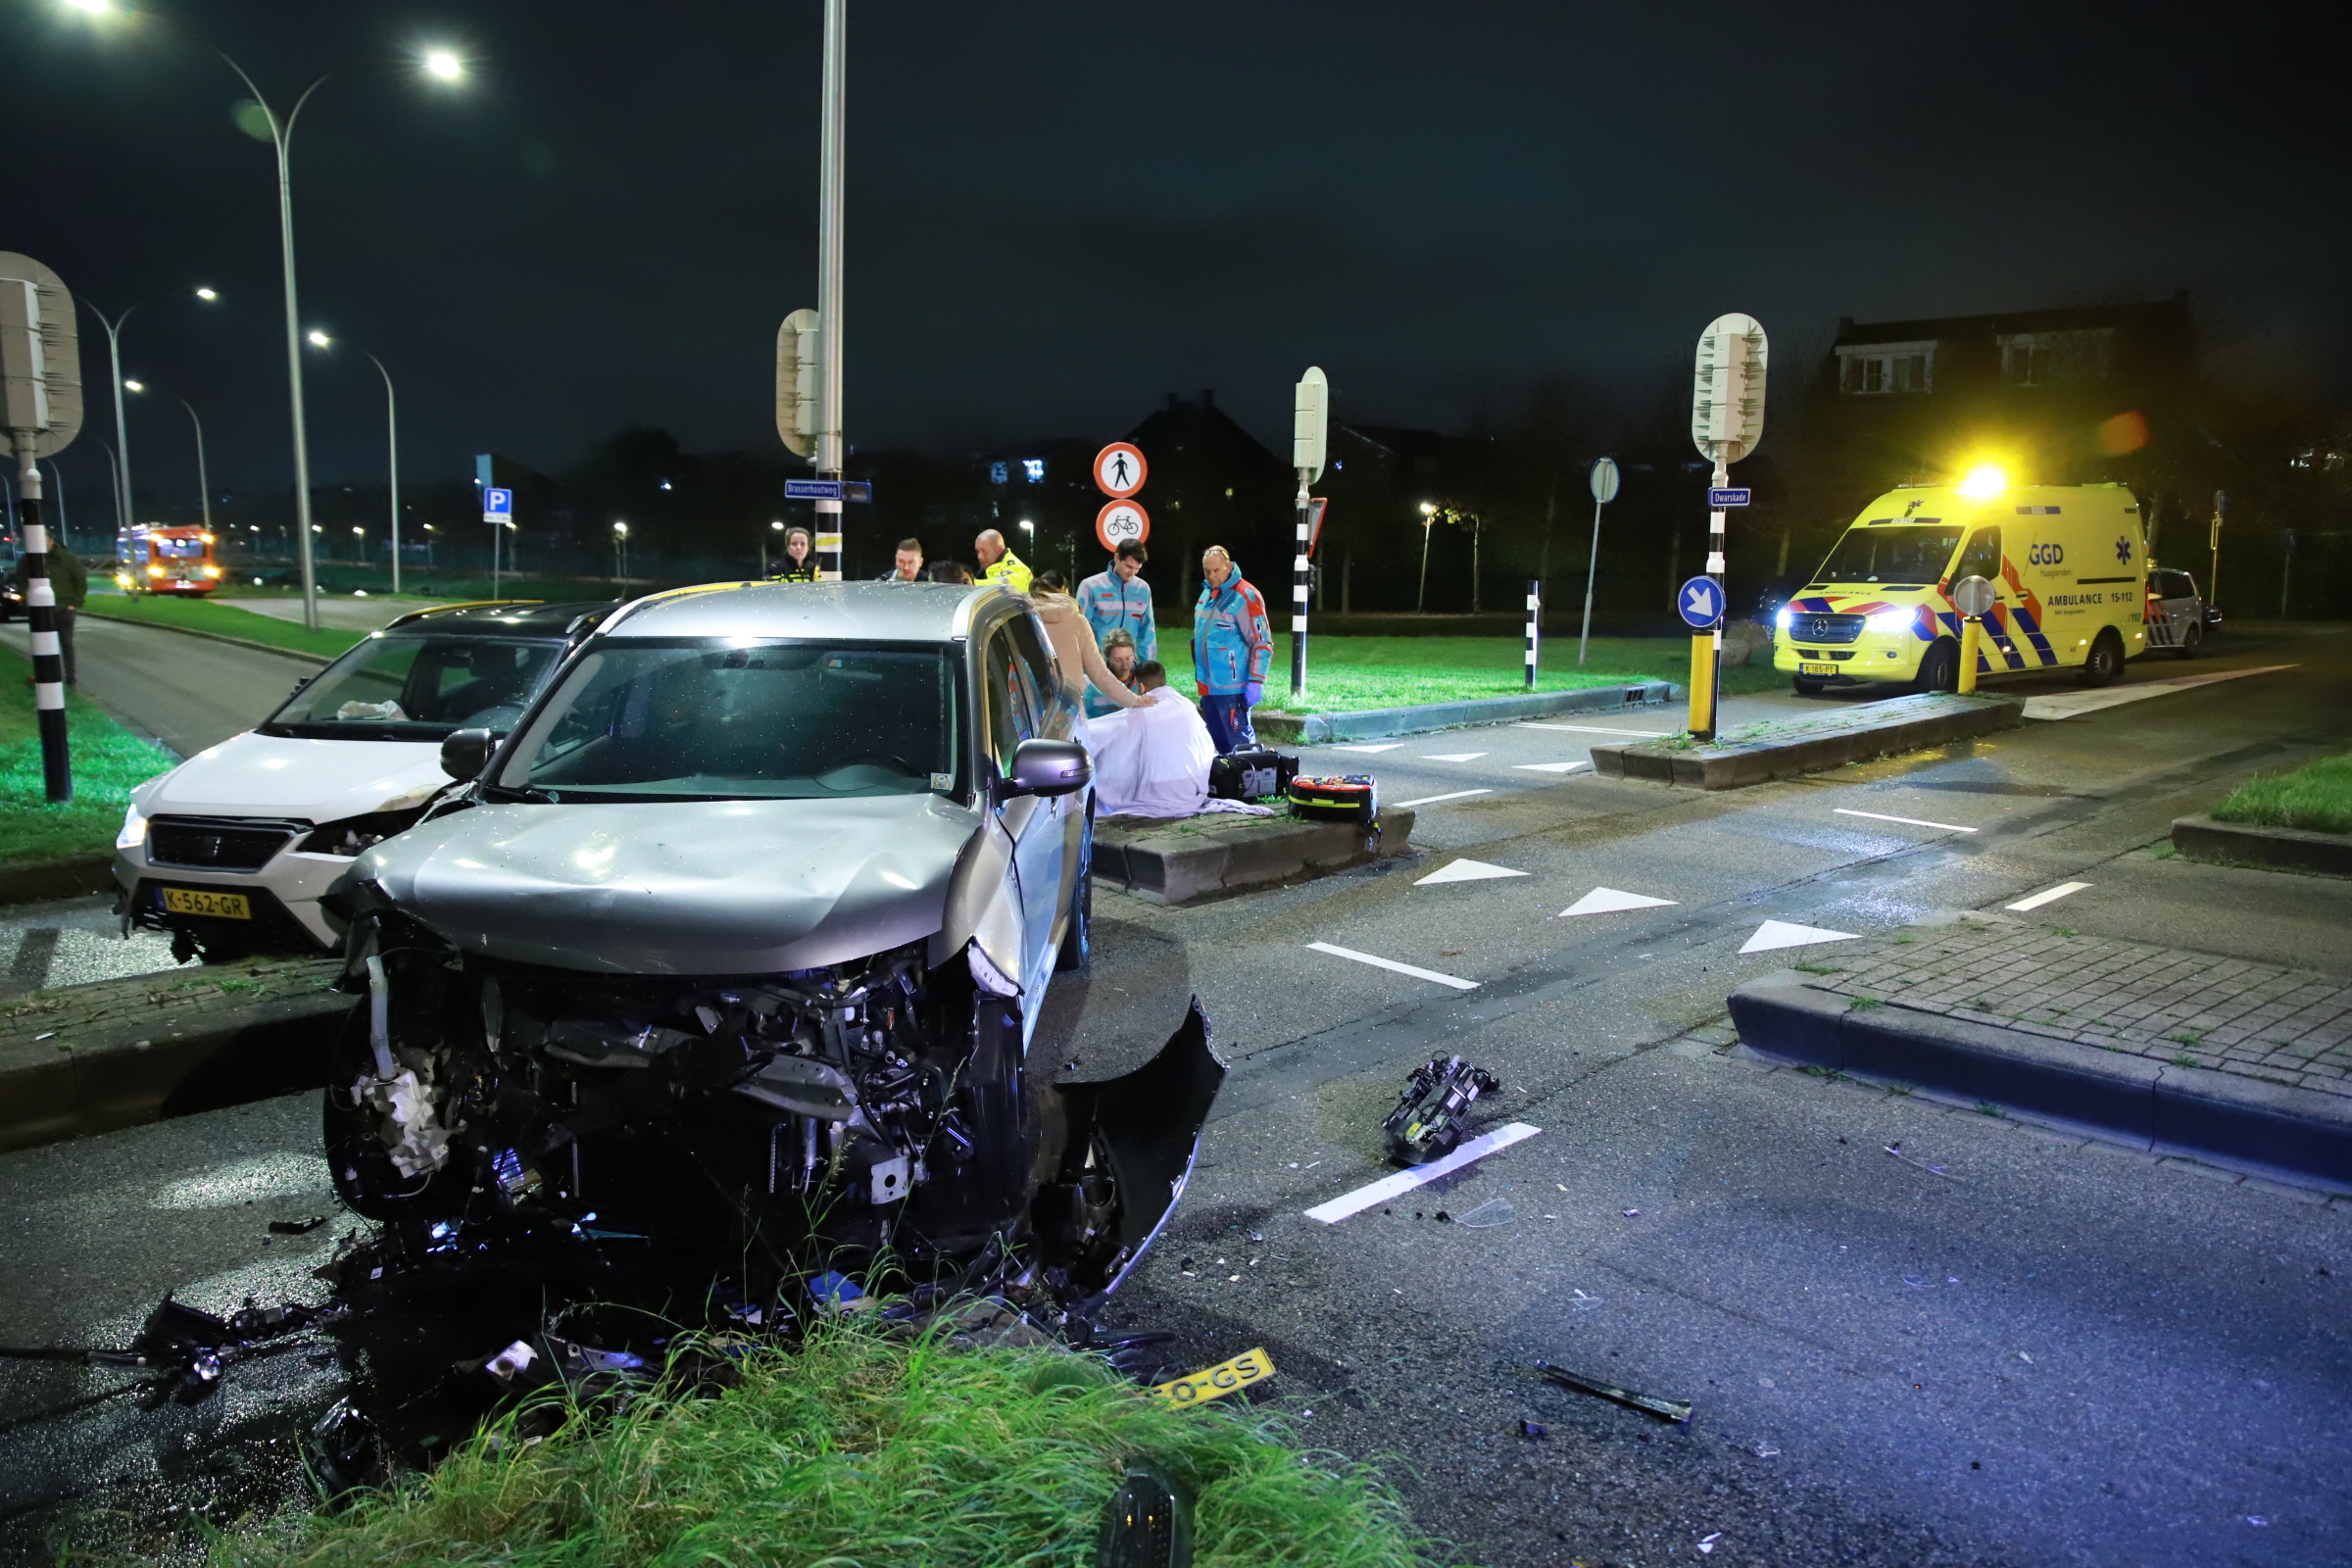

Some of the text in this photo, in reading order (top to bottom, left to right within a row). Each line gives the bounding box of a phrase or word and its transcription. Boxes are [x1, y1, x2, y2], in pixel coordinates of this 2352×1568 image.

[788, 483, 837, 497] Brasserhoutweg
[490, 491, 506, 511] P
[1715, 492, 1746, 503] Dwarskade
[2030, 544, 2064, 565] GGD
[2040, 568, 2072, 579] Haaglanden
[2048, 592, 2132, 606] AMBULANCE 15-112
[166, 890, 244, 915] K-562-GR
